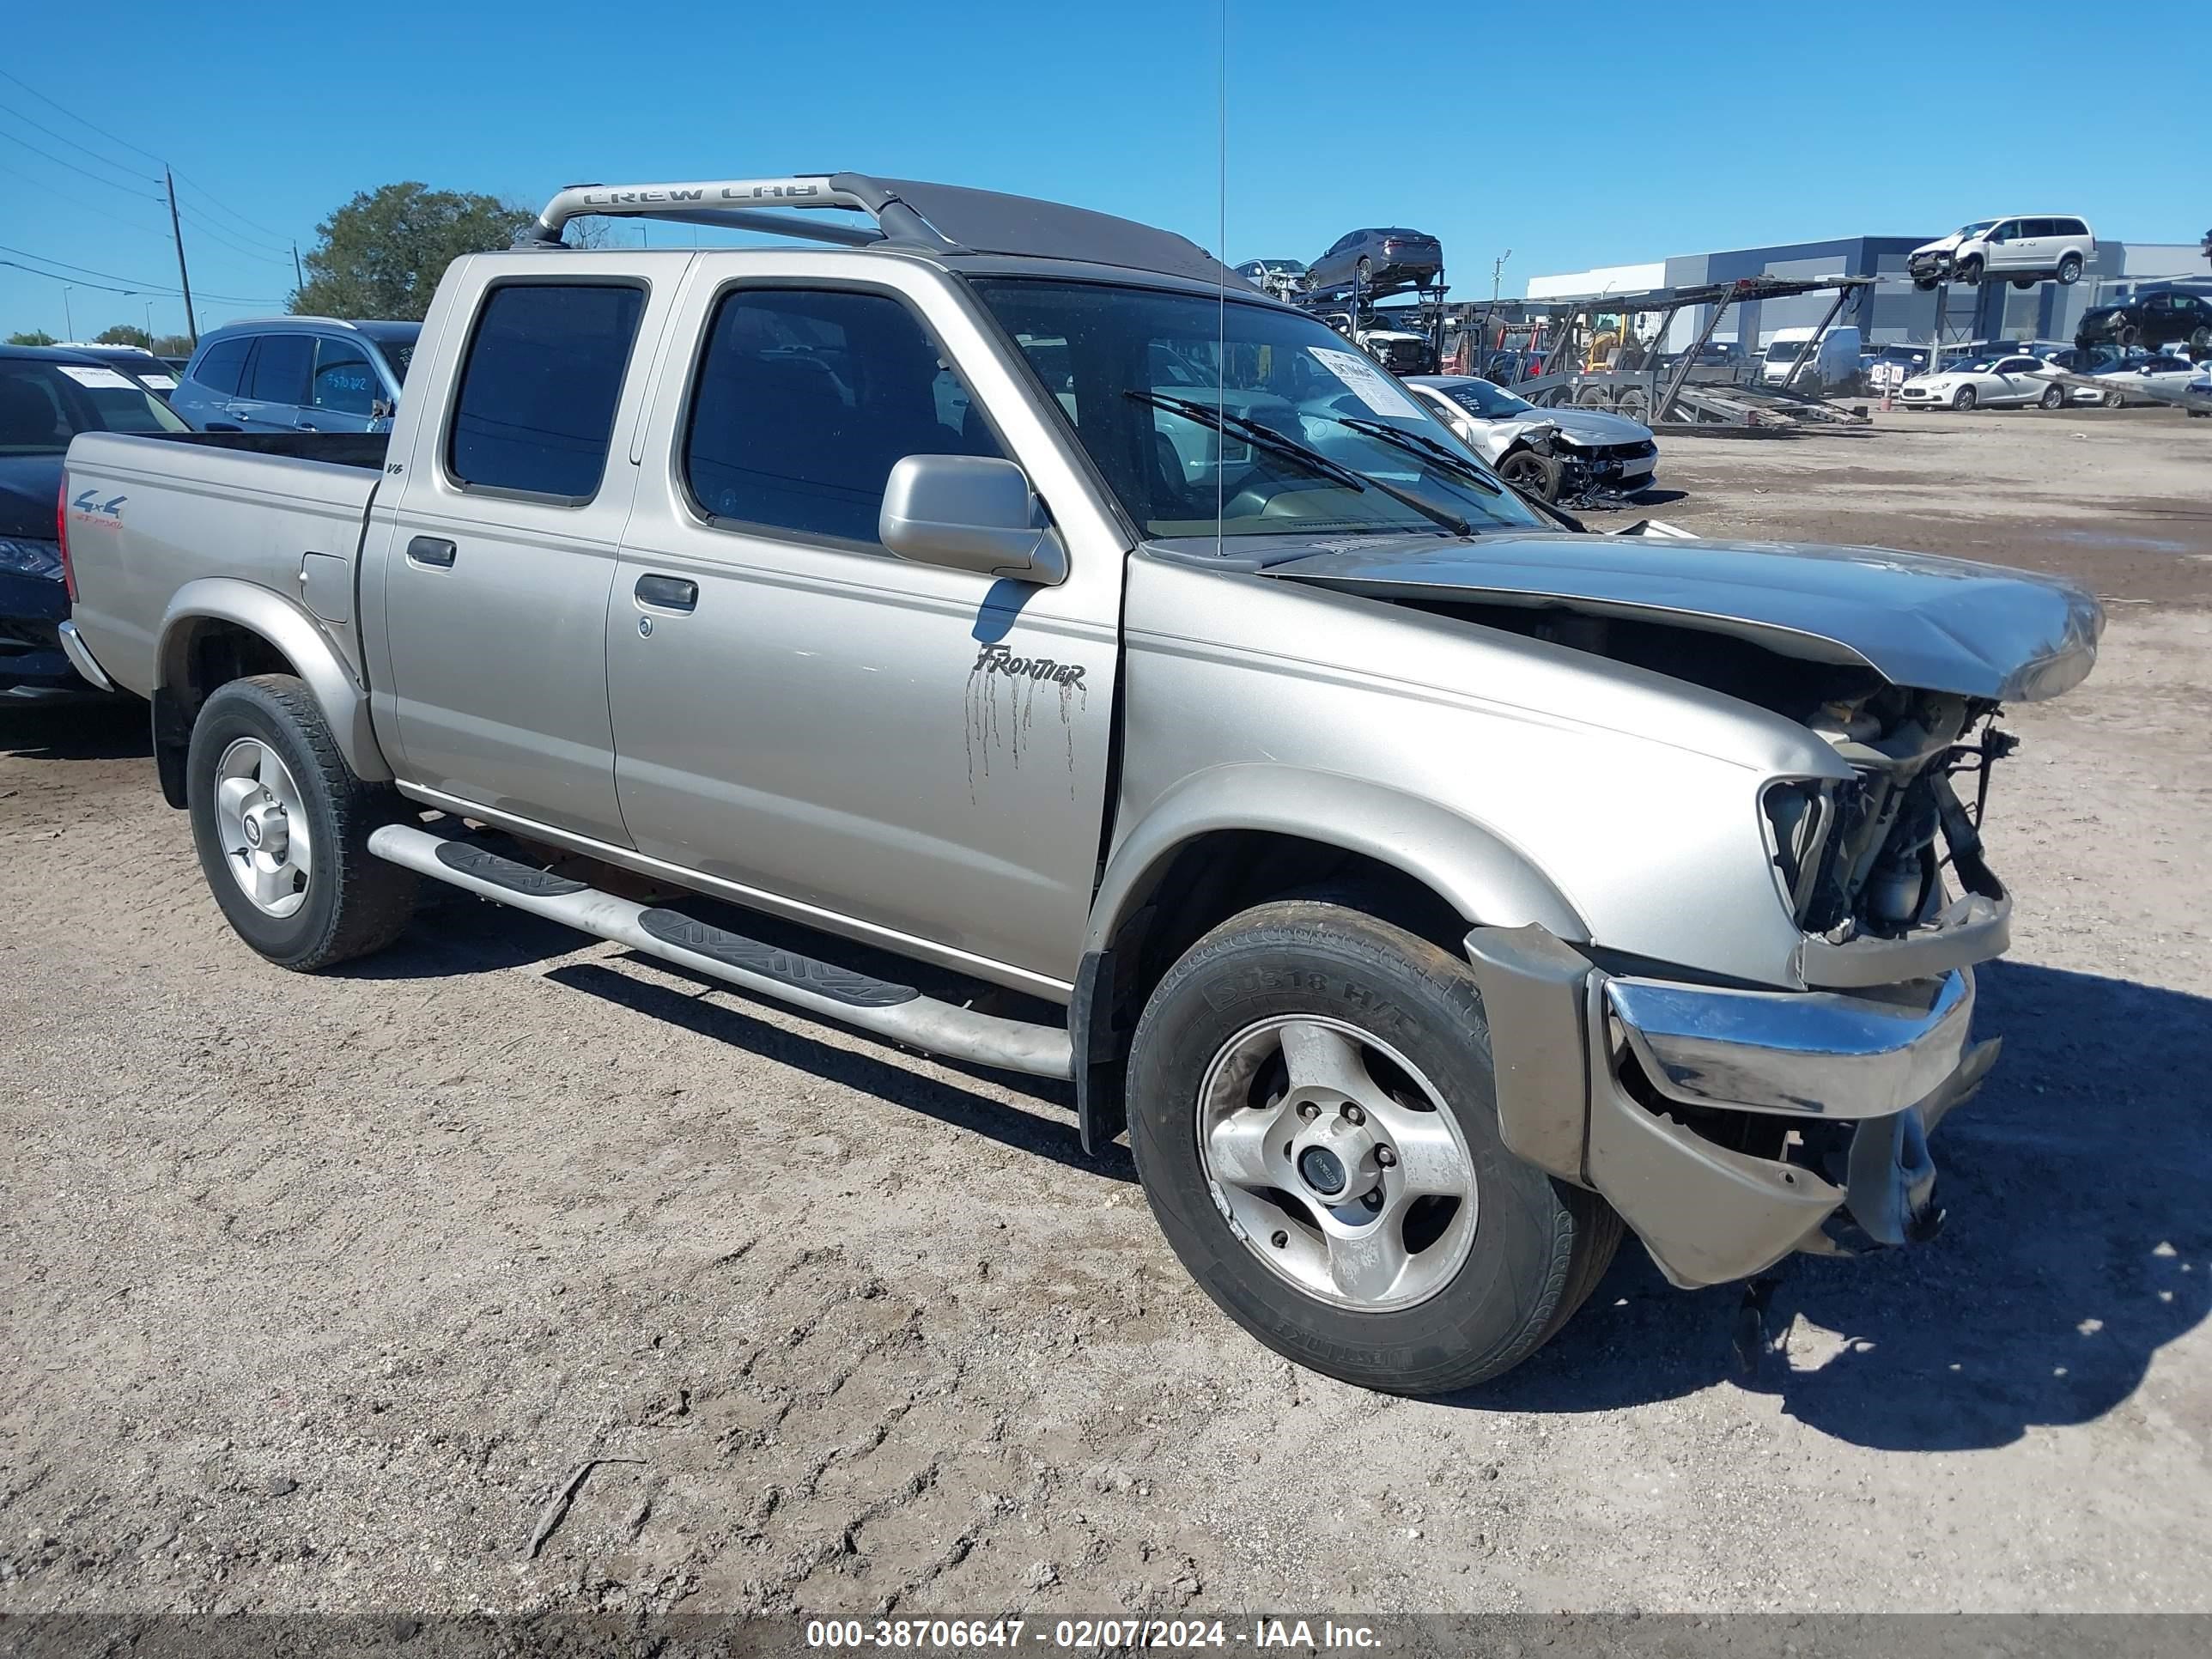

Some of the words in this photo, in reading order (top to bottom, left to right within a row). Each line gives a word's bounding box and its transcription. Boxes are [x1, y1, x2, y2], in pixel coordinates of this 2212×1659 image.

[583, 188, 702, 205] CREW
[386, 463, 404, 475] V6
[973, 643, 1087, 691] FRONTIER
